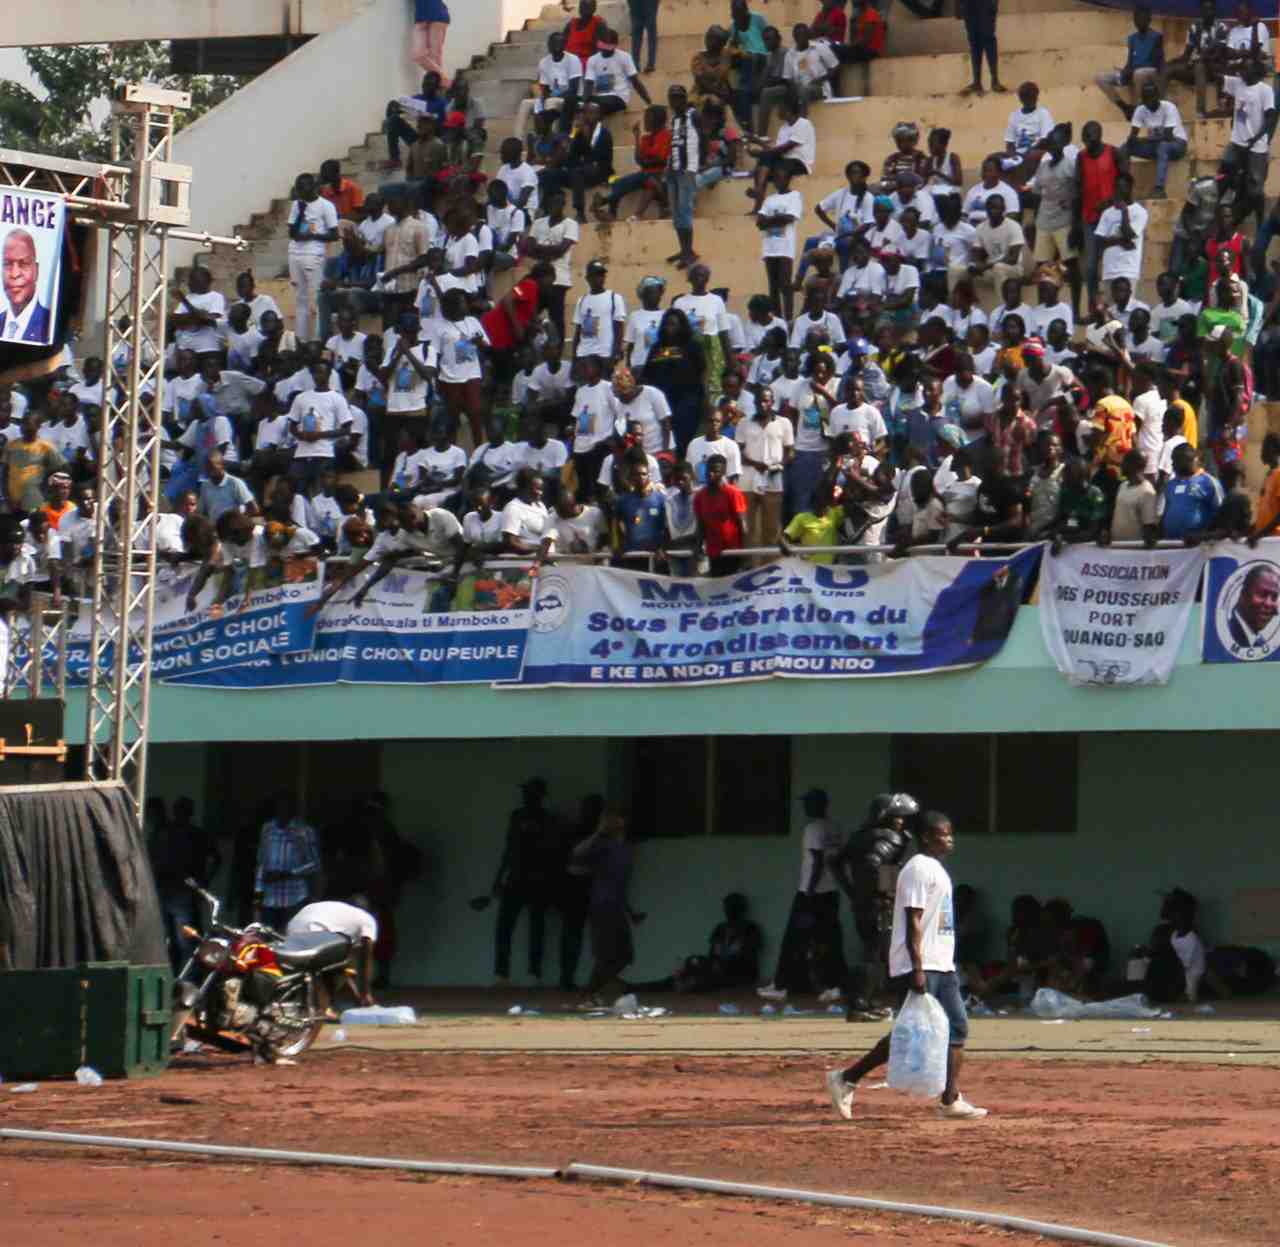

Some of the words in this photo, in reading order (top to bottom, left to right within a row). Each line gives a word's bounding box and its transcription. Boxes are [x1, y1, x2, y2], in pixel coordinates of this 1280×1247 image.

[1081, 562, 1170, 581] ASSOCIATION
[587, 611, 667, 633] Sous
[866, 605, 908, 624] du
[1089, 611, 1137, 627] PORT
[201, 632, 290, 663] SOCIALE
[420, 648, 444, 661] DU
[446, 645, 519, 661] PEUPLE
[590, 667, 603, 679] E
[608, 666, 637, 679] KE
[641, 666, 668, 679] BA
[731, 661, 744, 673] E
[775, 656, 825, 669] MOU
[831, 656, 875, 671] NDO
